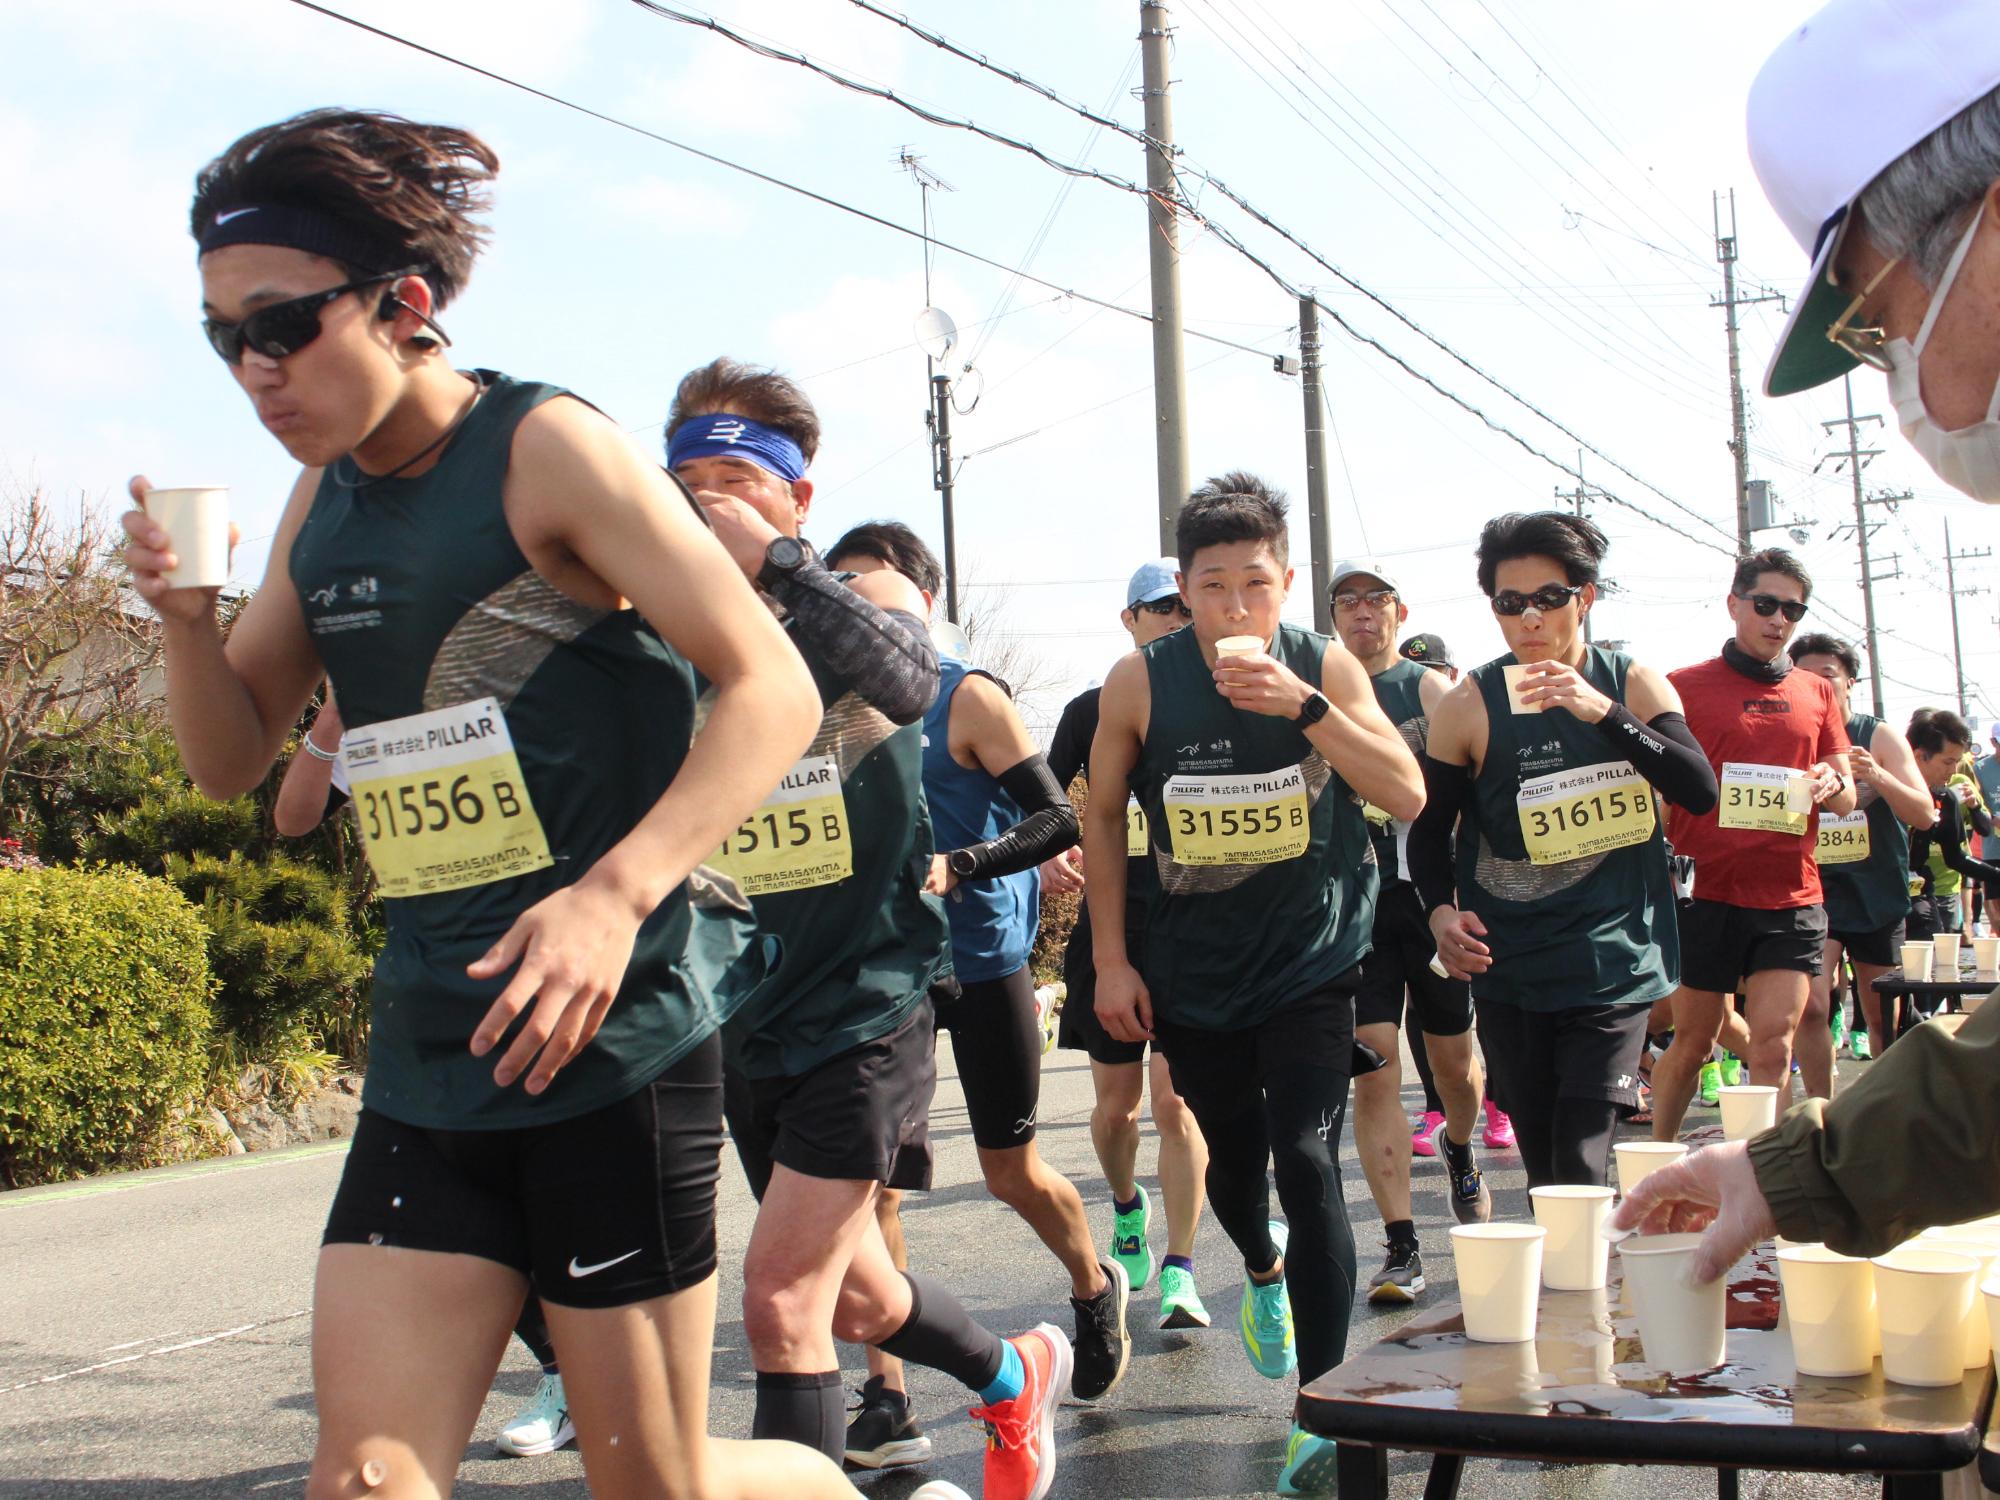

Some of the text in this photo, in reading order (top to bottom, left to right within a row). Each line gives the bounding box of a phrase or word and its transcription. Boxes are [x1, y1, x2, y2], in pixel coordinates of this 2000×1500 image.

[427, 717, 496, 749] PILLAR
[1638, 732, 1666, 755] YONEX
[1170, 775, 1300, 795] PILLAR 株式会社 PILLAR
[1521, 785, 1554, 797] PILLAR
[1559, 776, 1595, 790] 株式会社
[364, 774, 521, 841] 31556 B
[1728, 787, 1789, 810] 3154
[1178, 805, 1303, 837] 31555 B
[1530, 791, 1648, 837] 31615 B
[822, 815, 841, 841] B
[1577, 828, 1649, 850] TAMBASASAYAMA
[1815, 830, 1866, 847] 384 A
[1223, 842, 1302, 858] TAMBASASAYAMA
[742, 862, 841, 885] TAMBASASAYAMA
[763, 877, 815, 890] MARATHON
